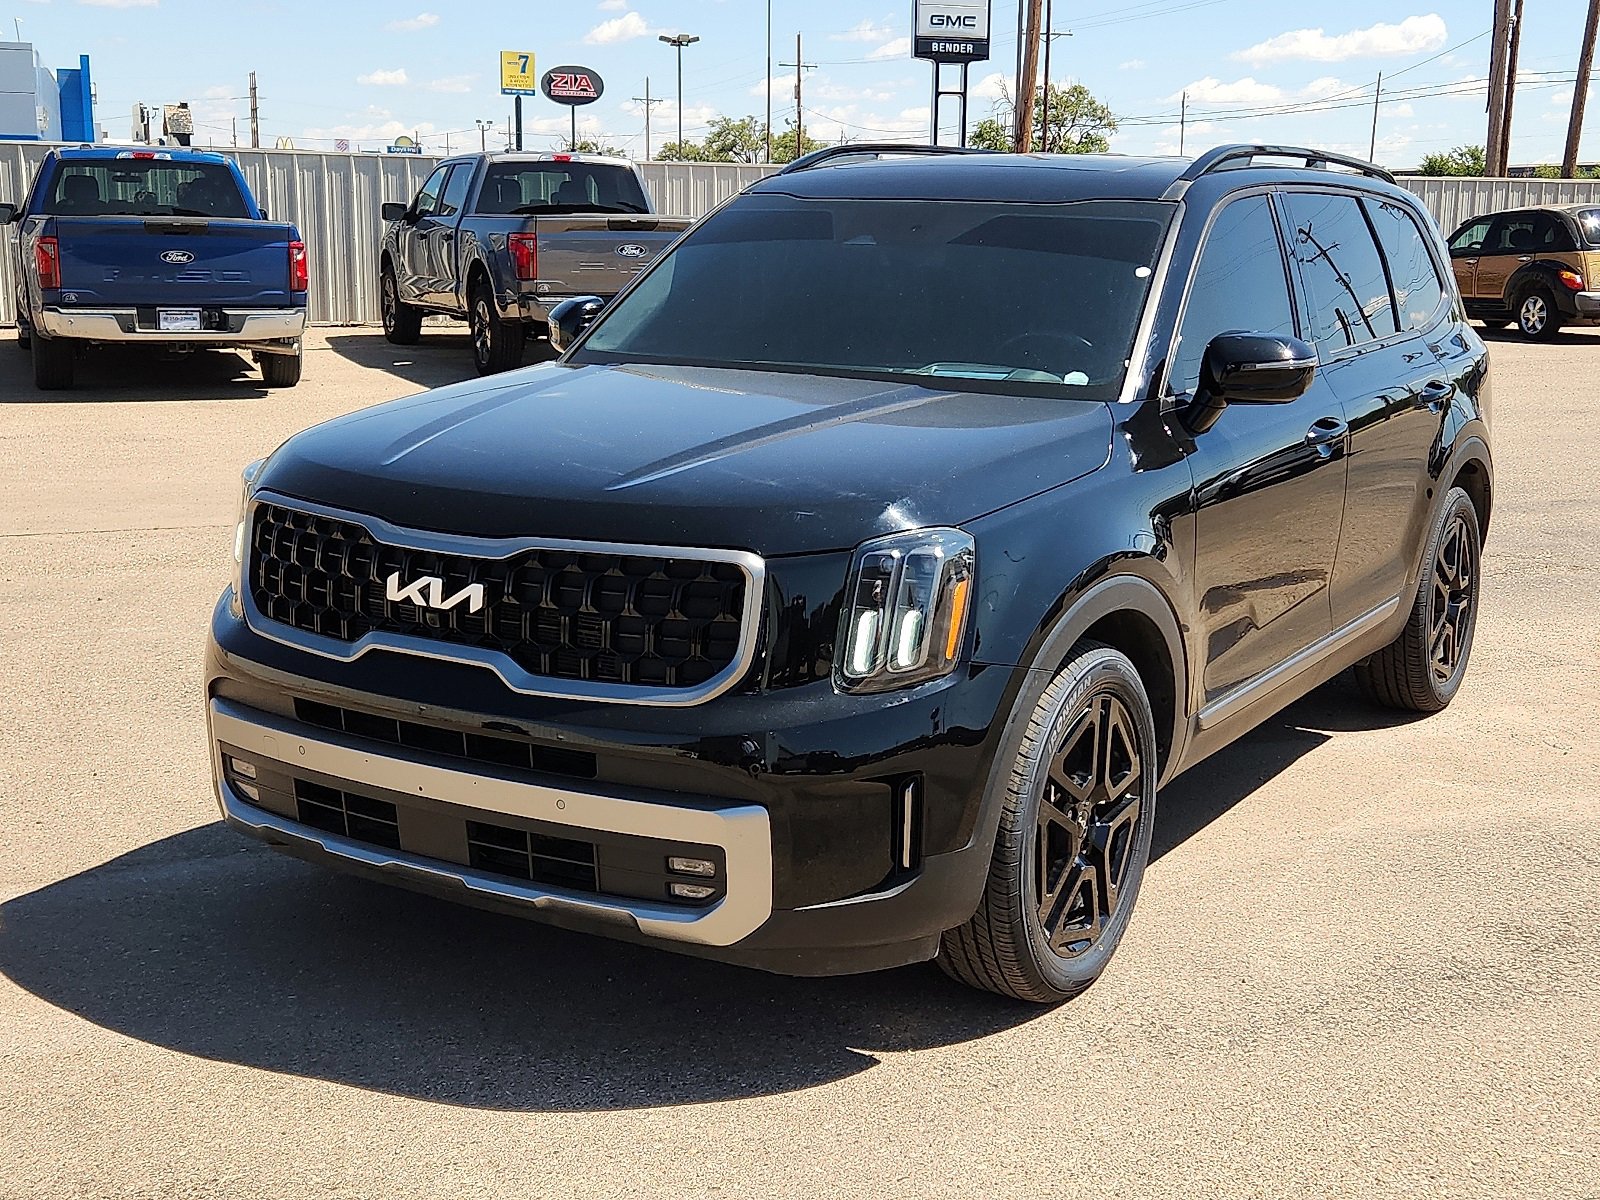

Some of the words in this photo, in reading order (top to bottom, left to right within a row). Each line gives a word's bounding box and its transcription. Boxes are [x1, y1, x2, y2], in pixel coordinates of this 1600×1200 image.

[930, 15, 976, 27] GMC
[931, 42, 974, 53] BENDER
[518, 55, 529, 73] 7
[550, 73, 594, 91] ZIA
[386, 571, 483, 614] KIA
